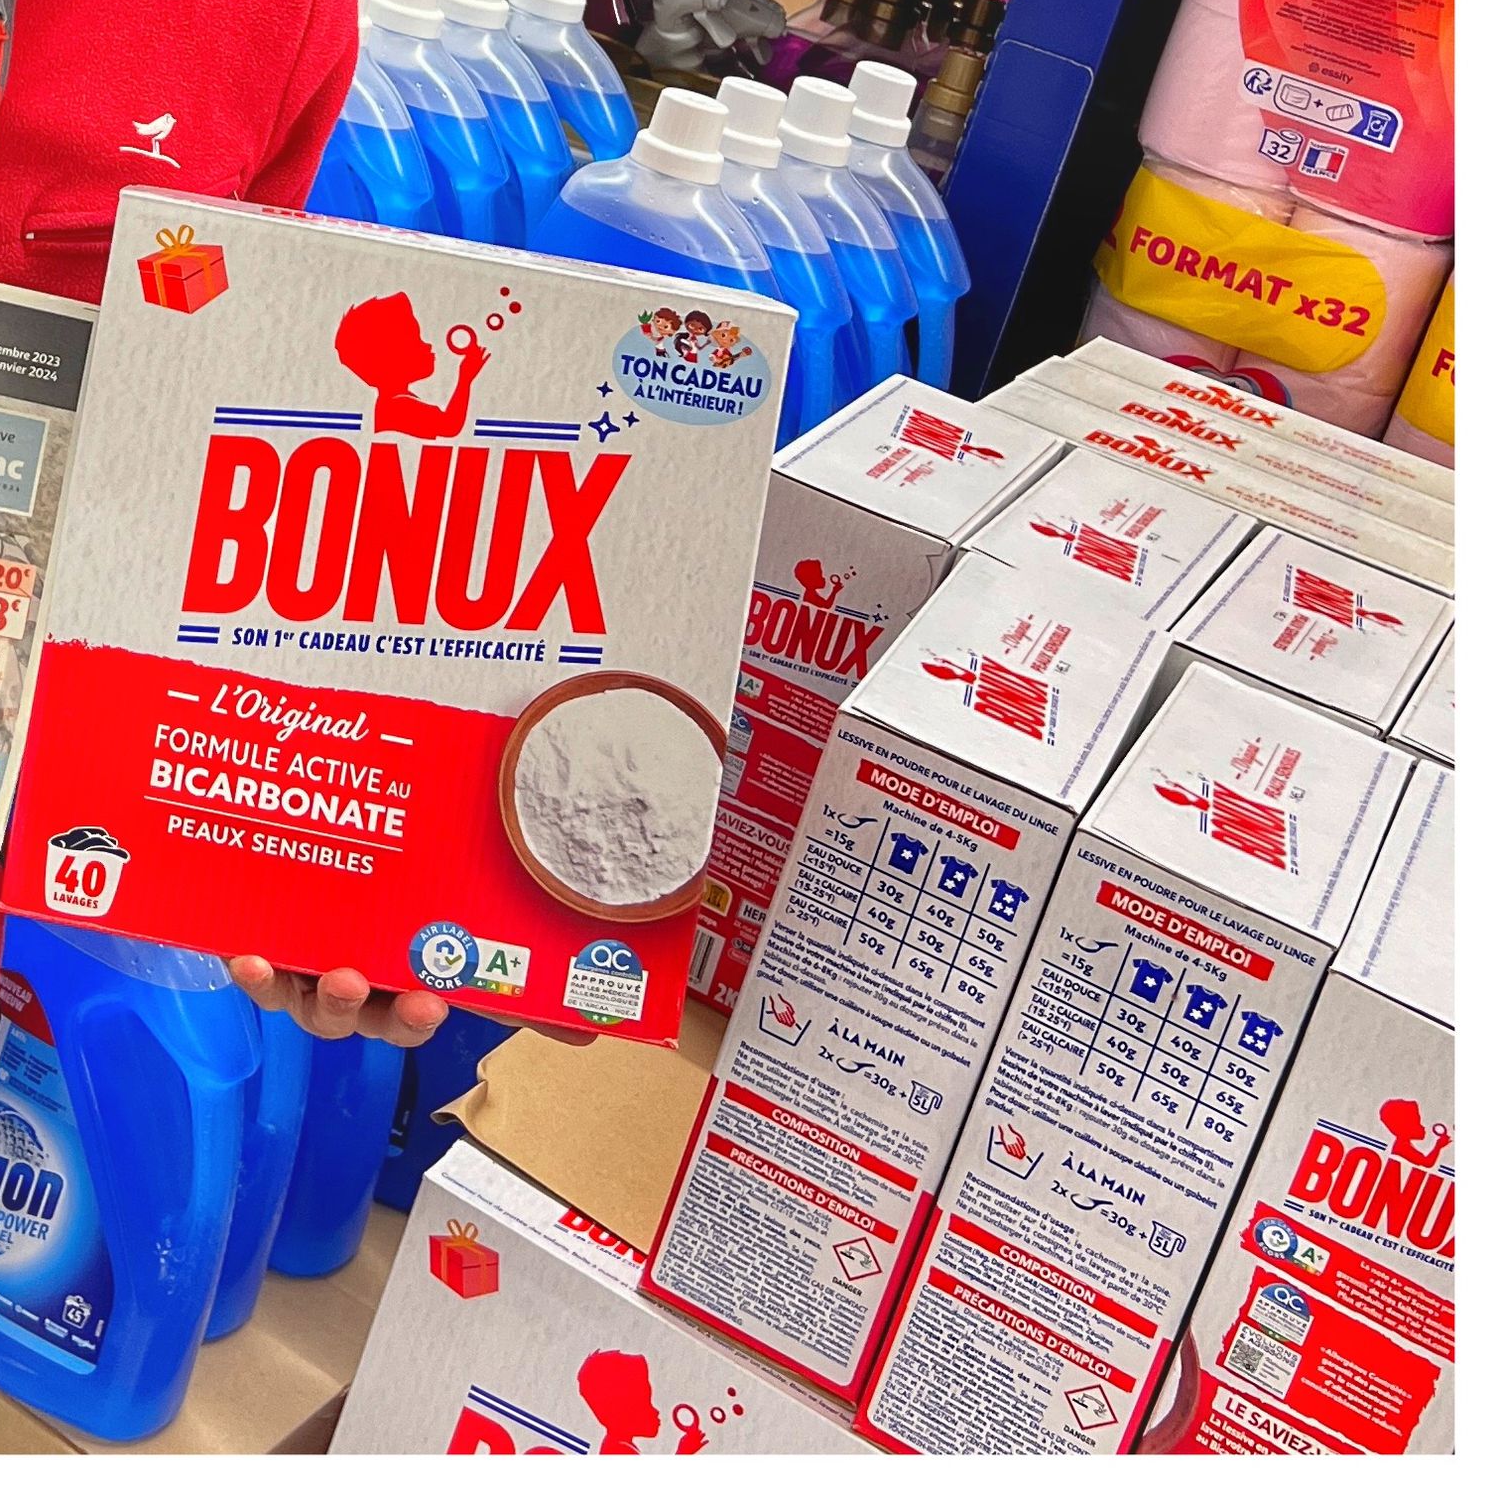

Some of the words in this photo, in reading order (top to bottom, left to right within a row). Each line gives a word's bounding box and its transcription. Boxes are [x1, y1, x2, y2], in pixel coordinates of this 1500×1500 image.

[1320, 63, 1354, 84] essity
[1301, 166, 1338, 180] FRANCE
[1129, 225, 1293, 307] FORMAT
[1293, 294, 1371, 337] x32
[28, 365, 58, 382] 2024
[32, 352, 61, 367] 2023
[621, 354, 669, 382] TON
[670, 364, 763, 399] CADEAU
[1083, 429, 1213, 484] BONUX
[181, 434, 632, 636] BONUX
[232, 626, 269, 647] SON
[298, 631, 371, 655] CADEAU
[375, 634, 423, 658] C'EST
[428, 637, 546, 663] L'EFFICACITÉ
[744, 588, 885, 681] BONUX
[211, 682, 370, 742] L'Original
[153, 724, 281, 772] FORMULE
[286, 751, 384, 796] ACTIVE
[149, 756, 408, 839] BICARBONATE
[837, 728, 875, 752] LESSIVE
[875, 744, 890, 758] EN
[890, 751, 931, 779] POUDRE
[931, 770, 960, 792] POUR
[960, 784, 972, 797] LE
[972, 789, 1012, 814] LAVAGE
[1012, 806, 1028, 821] DU
[1029, 813, 1059, 837] LINGE
[870, 767, 920, 803] MODE
[921, 791, 1001, 839] D'EMPLOI
[166, 814, 246, 850] PEAUX
[250, 828, 375, 876] SENSIBLES
[883, 799, 928, 829] Machine
[929, 819, 944, 835] de
[946, 828, 979, 852] 4-5Kg
[52, 854, 108, 898] 40
[807, 844, 827, 861] EAU
[826, 851, 863, 876] DOUCE
[876, 879, 905, 904] 30g
[419, 924, 438, 942] AIR
[442, 924, 474, 951] LABEL
[807, 904, 849, 930] CALCAIRE
[917, 929, 946, 954] 50g
[418, 971, 463, 990] SCORE
[572, 973, 642, 993] APPROUVÉ
[957, 980, 987, 1005] 80g
[841, 1027, 861, 1047] LA
[863, 1038, 906, 1068] MAIN
[1287, 1128, 1455, 1258] BONU
[831, 1275, 864, 1297] DANGER
[999, 1244, 1096, 1305] COMPOSITION
[952, 1283, 1046, 1344] PRÉCAUTIONS
[1046, 1335, 1112, 1380] D'EMPLOI
